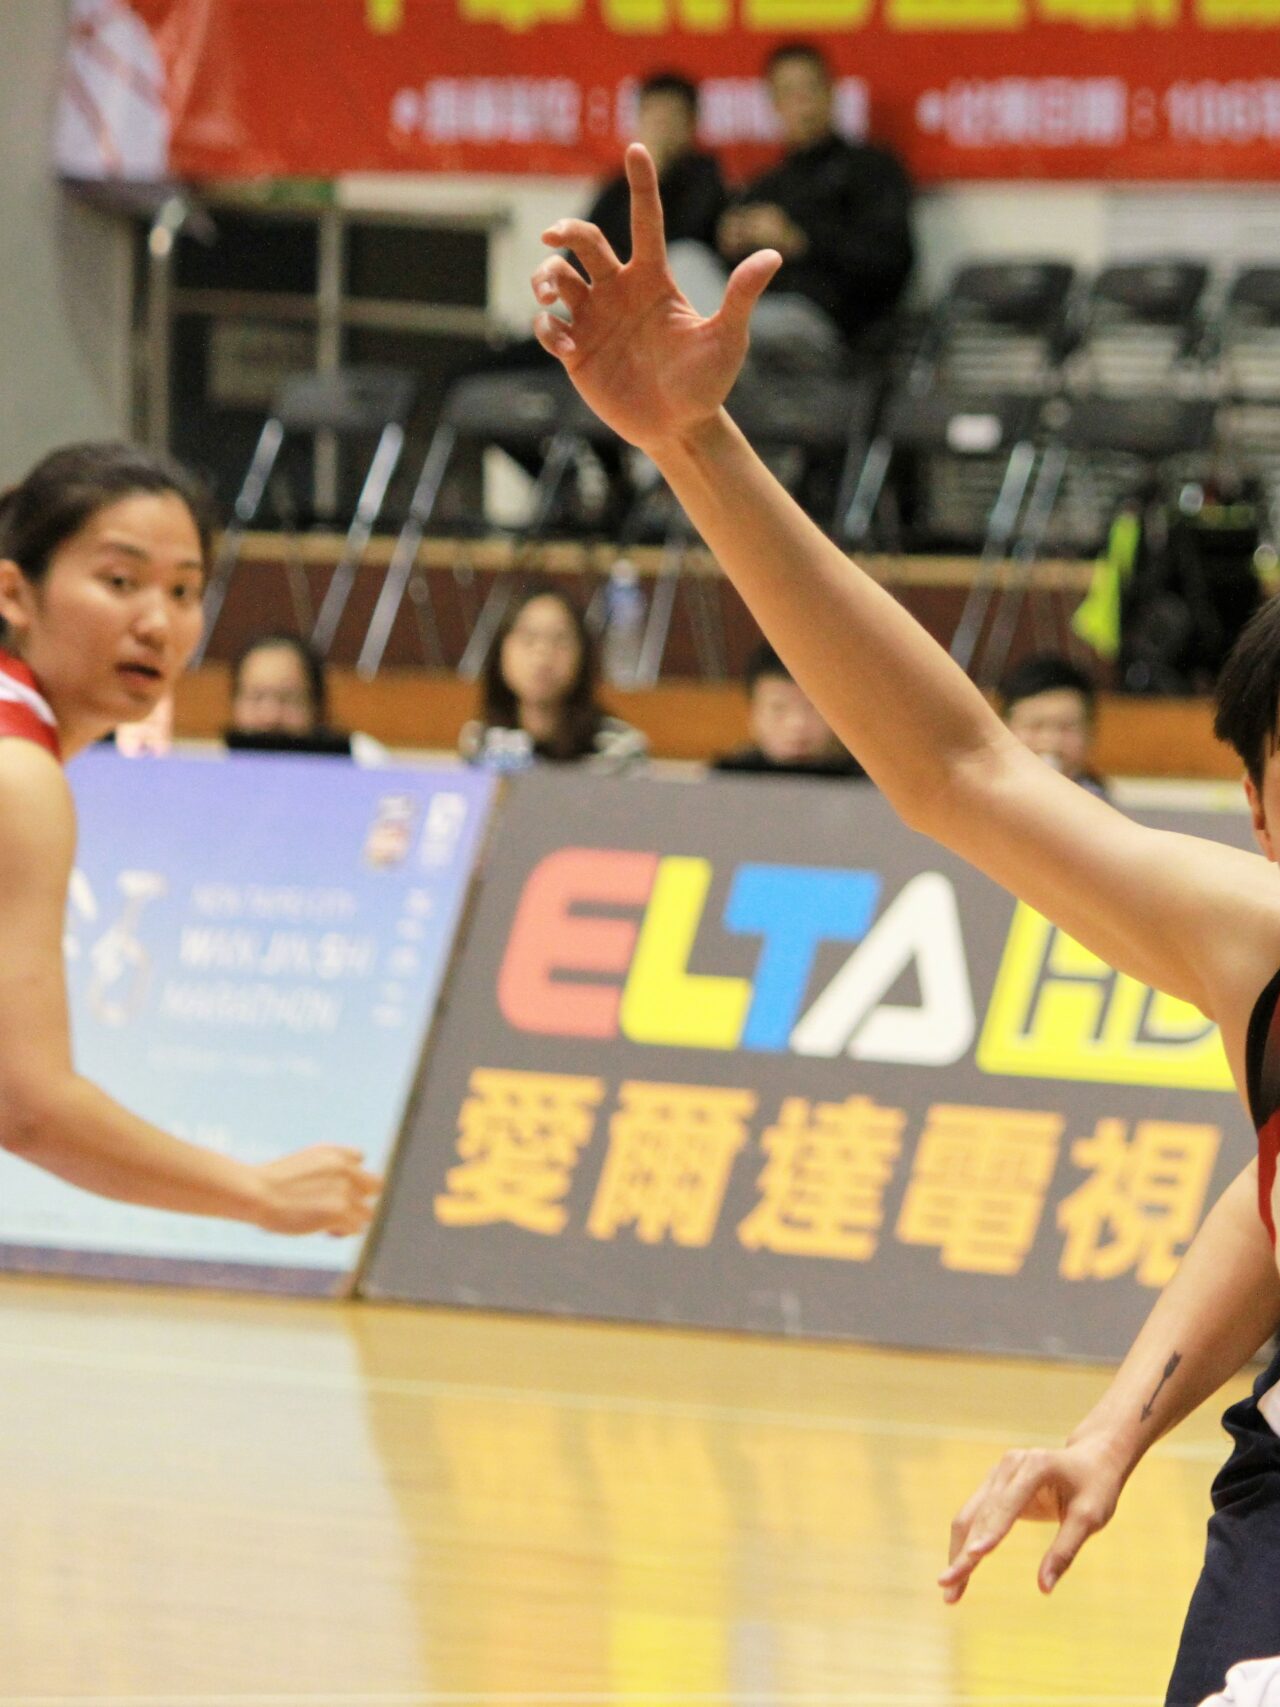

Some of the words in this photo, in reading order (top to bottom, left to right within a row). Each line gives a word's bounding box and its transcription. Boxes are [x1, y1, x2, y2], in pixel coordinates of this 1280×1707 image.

[497, 846, 976, 1066] ELTA
[435, 1067, 1222, 1288] 愛爾達電視
